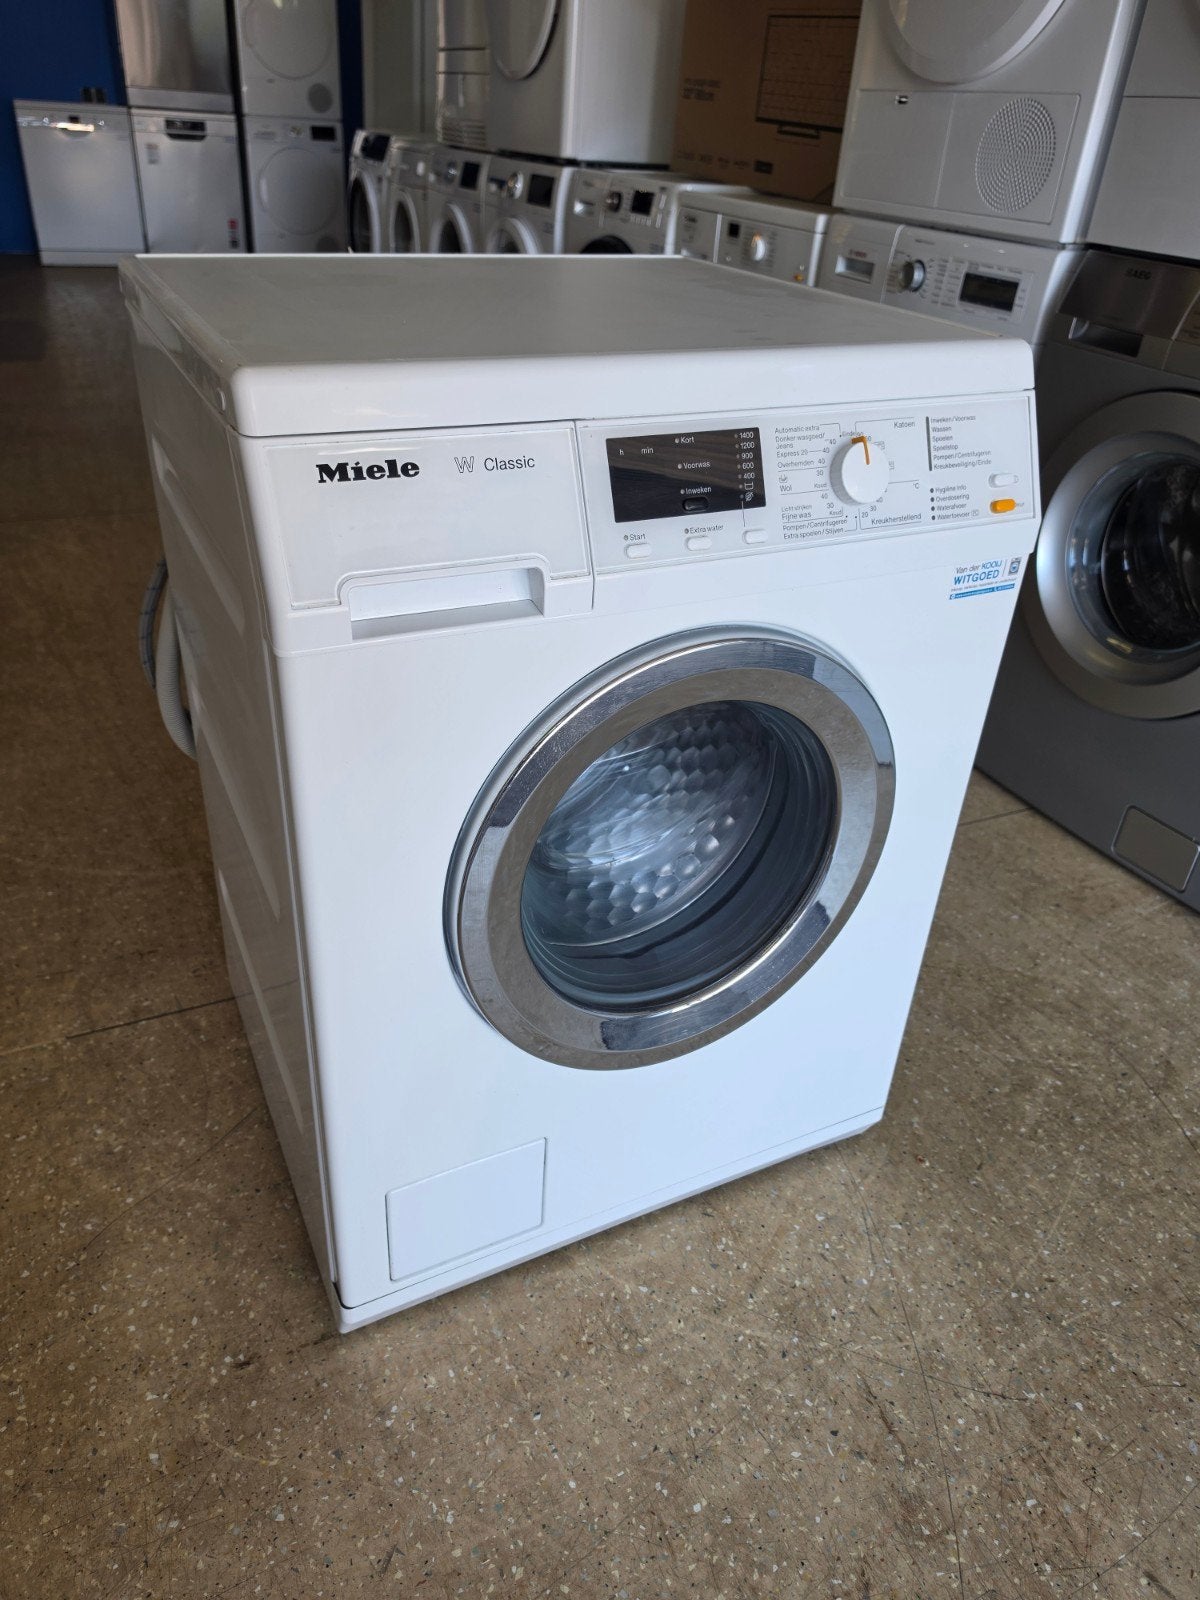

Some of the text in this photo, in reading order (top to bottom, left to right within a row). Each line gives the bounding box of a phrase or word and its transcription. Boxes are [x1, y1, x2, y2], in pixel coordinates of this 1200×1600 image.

[893, 421, 916, 429] Katoen
[740, 431, 754, 439] 1400
[775, 435, 796, 443] Donker
[932, 435, 953, 443] Spoelen
[680, 436, 695, 444] Kort
[740, 441, 755, 449] 1200
[932, 443, 959, 452] Spoelstop
[619, 448, 624, 456] h
[776, 450, 800, 459] Express
[454, 455, 536, 473] W Classic
[683, 460, 711, 469] Voorwas
[777, 459, 814, 468] Overhemden
[315, 459, 420, 483] Miele
[685, 485, 712, 495] Inweken
[779, 484, 793, 492] Wol
[935, 493, 970, 502] Overdosering
[936, 503, 967, 511] Waterafvoer
[781, 511, 812, 521] Fijne was
[861, 511, 869, 519] 20
[871, 513, 922, 525] Kreukherstellend
[936, 511, 970, 520] Watertoevoer
[689, 524, 724, 534] Extra water
[782, 519, 848, 531] Pompen/Centrifugeren
[629, 533, 646, 541] Start
[783, 532, 799, 540] Extra
[955, 566, 968, 574] Van
[968, 564, 981, 572] der
[953, 569, 1000, 585] WITGOED
